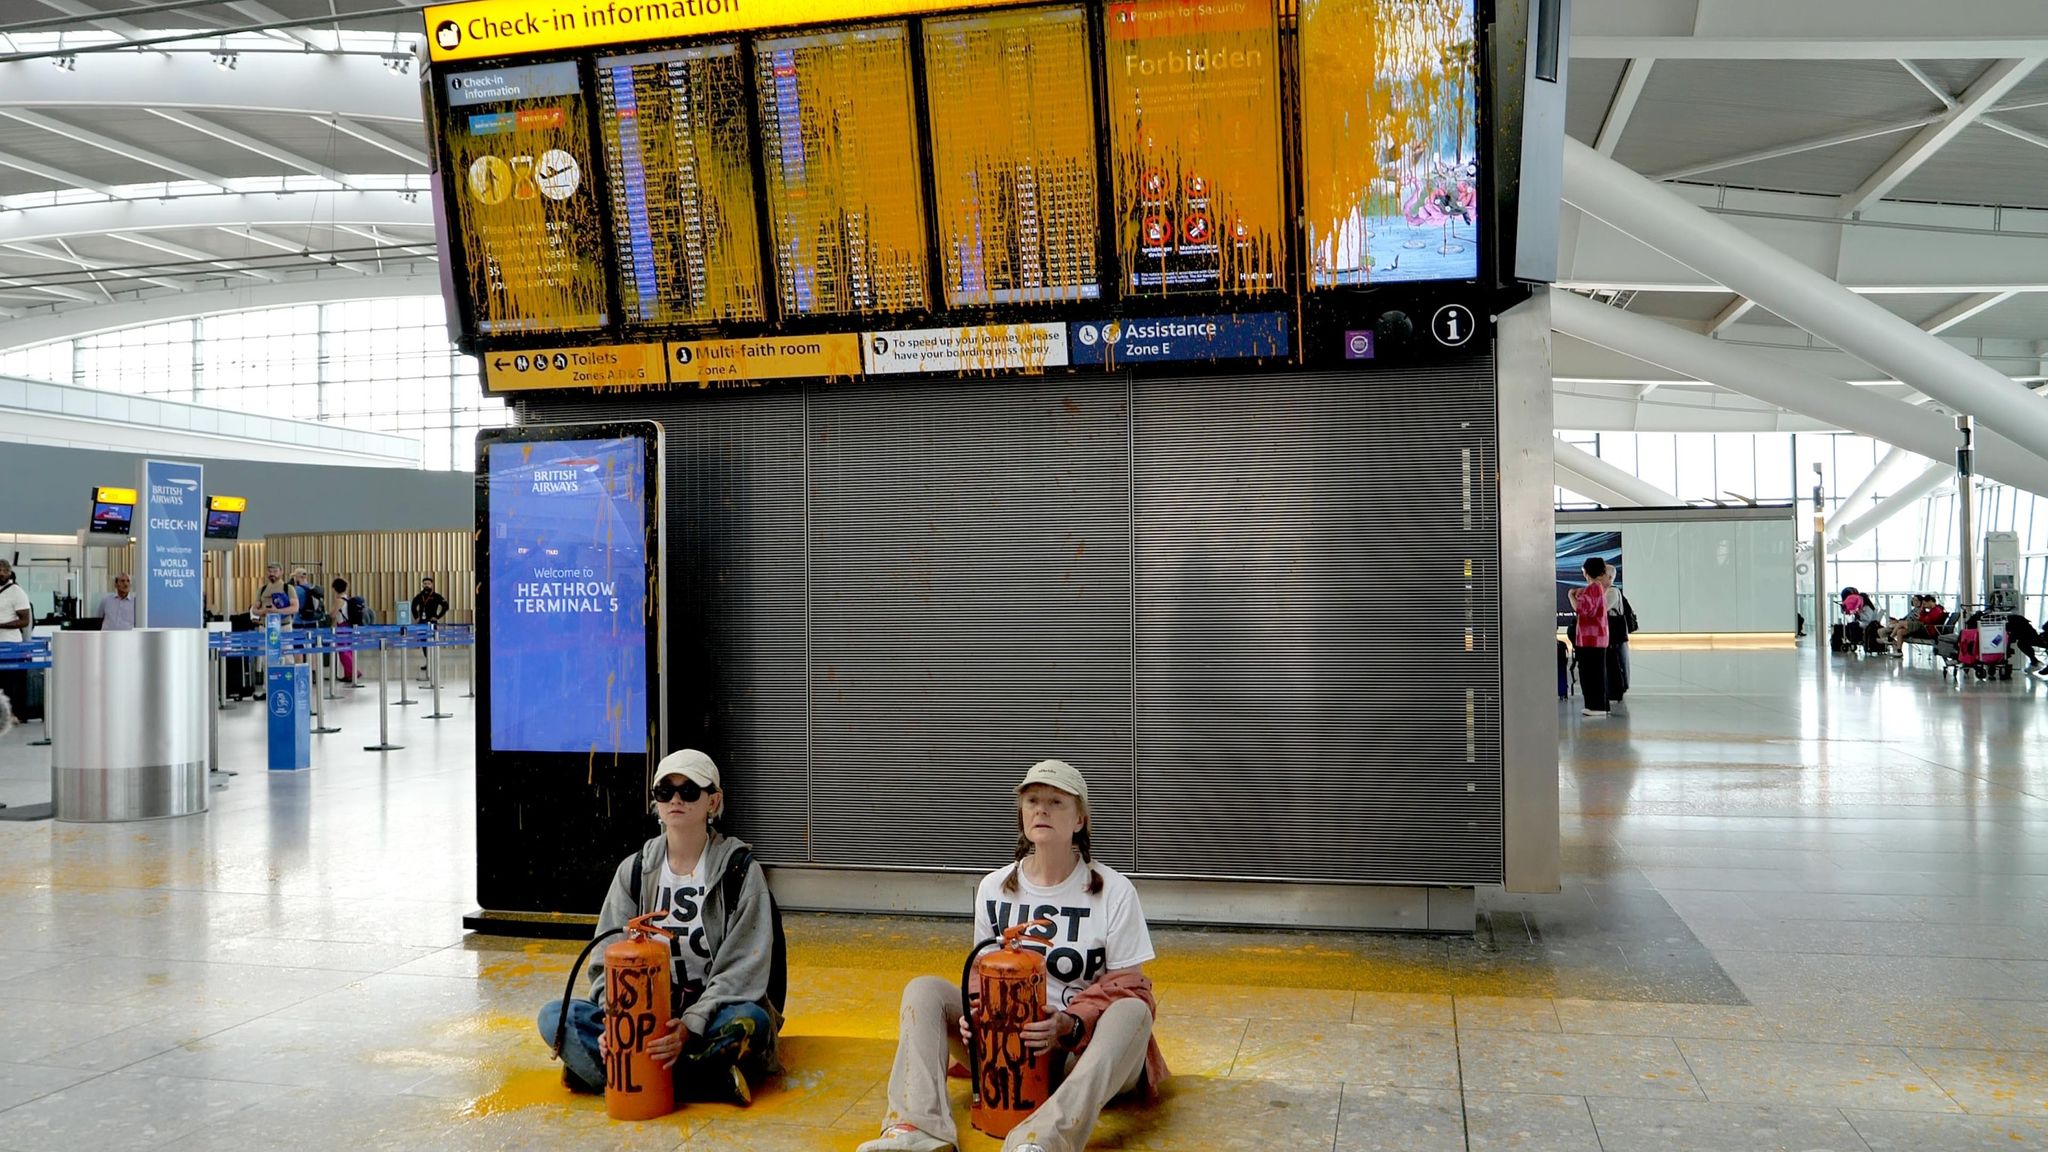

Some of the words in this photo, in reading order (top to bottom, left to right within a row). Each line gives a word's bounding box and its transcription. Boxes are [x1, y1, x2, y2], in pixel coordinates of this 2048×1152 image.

[468, 8, 576, 41] Check-in
[582, 0, 740, 28] information
[1125, 47, 1263, 77] Forbidden
[463, 75, 504, 88] Check-in
[464, 85, 521, 100] information
[546, 221, 569, 231] sure
[1125, 322, 1217, 339] Assistance
[893, 338, 906, 348] To
[907, 337, 938, 349] speed
[940, 337, 953, 347] up
[1126, 344, 1159, 356] Zone
[1162, 342, 1171, 355] E
[695, 343, 776, 360] Multi-faith
[780, 343, 821, 356] room
[894, 352, 919, 361] have
[920, 350, 944, 361] your
[946, 347, 992, 358] boarding
[570, 352, 618, 366] Toilets
[572, 371, 605, 381] Zones
[637, 368, 646, 379] G
[728, 364, 738, 375] A
[533, 469, 577, 482] BRITISH
[152, 485, 183, 496] BRITISH
[531, 480, 579, 493] AIRWAYS
[150, 494, 184, 506] AIRWAYS
[150, 518, 198, 531] CHECK-IN
[155, 545, 166, 553] We
[166, 545, 193, 554] welcome
[159, 558, 188, 568] WORLD
[152, 568, 196, 578] TRAVELLER
[533, 567, 580, 579] Welcome
[582, 567, 594, 578] to
[164, 578, 184, 588] PLUS
[517, 581, 615, 597] HEATHROW
[513, 598, 603, 613] TERMINAL
[609, 597, 619, 612] 5
